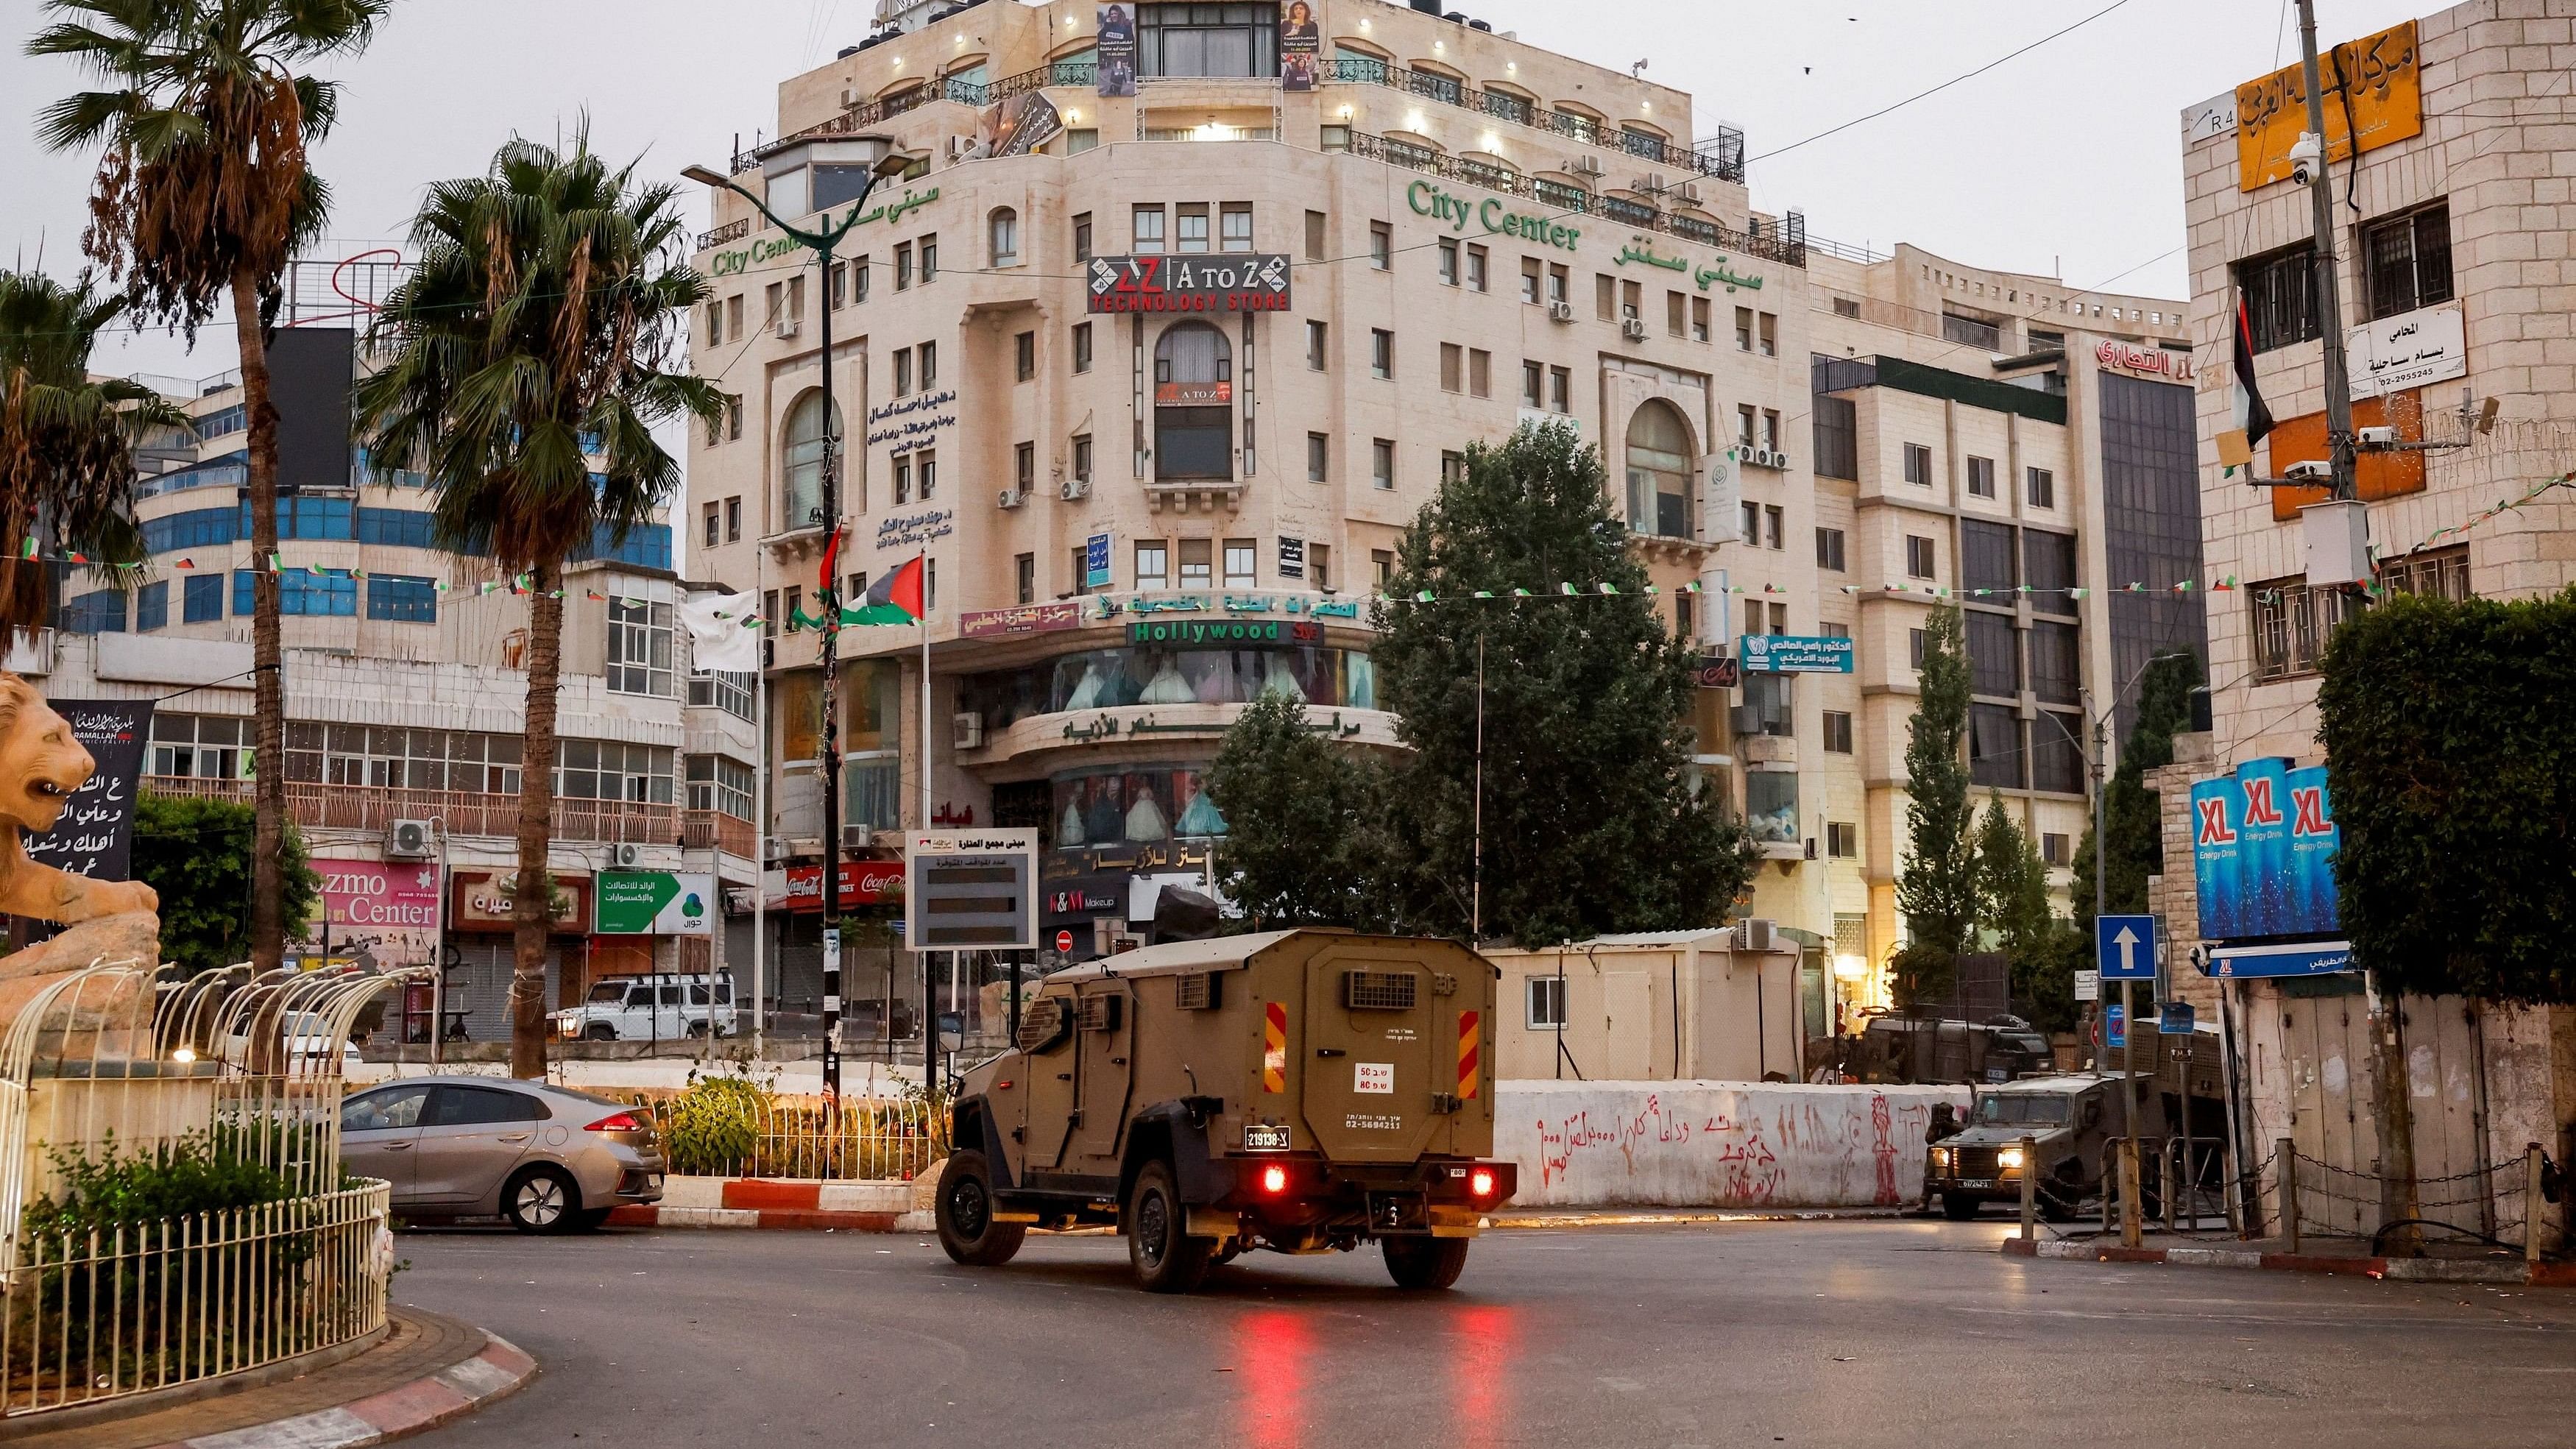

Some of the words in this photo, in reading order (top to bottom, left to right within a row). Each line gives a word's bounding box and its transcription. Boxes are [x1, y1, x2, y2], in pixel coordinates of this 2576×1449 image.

[2355, 34, 2415, 96] مركز
[887, 187, 940, 224] سيتي
[1408, 180, 1472, 230] City
[1480, 198, 1581, 251] Center
[712, 248, 749, 277] City
[1613, 235, 1688, 272] سنتر
[1177, 261, 1195, 288] A
[1242, 261, 1260, 288] Z
[1696, 256, 1763, 292] سيتي
[1091, 294, 1217, 313] TECHNOLOGY
[1227, 292, 1288, 312] STORE
[2389, 322, 2418, 344] المحامي
[2415, 347, 2444, 364] بسام
[2380, 368, 2433, 386] 02-2955245
[1134, 622, 1278, 644] Hollywood
[2243, 779, 2282, 825] XL
[2292, 789, 2332, 835] XL
[2198, 798, 2235, 844] XL
[958, 838, 983, 851] المنارة
[985, 840, 1004, 850] مجمع
[1005, 839, 1026, 849] مبنى
[2246, 832, 2267, 842] Energy
[2293, 842, 2315, 851] Energy
[2200, 851, 2221, 860] Energy
[2222, 849, 2237, 858] Drink
[605, 881, 637, 890] للاتصالات
[350, 897, 434, 924] Center
[1085, 899, 1114, 908] Makeup
[2219, 959, 2232, 974] XL
